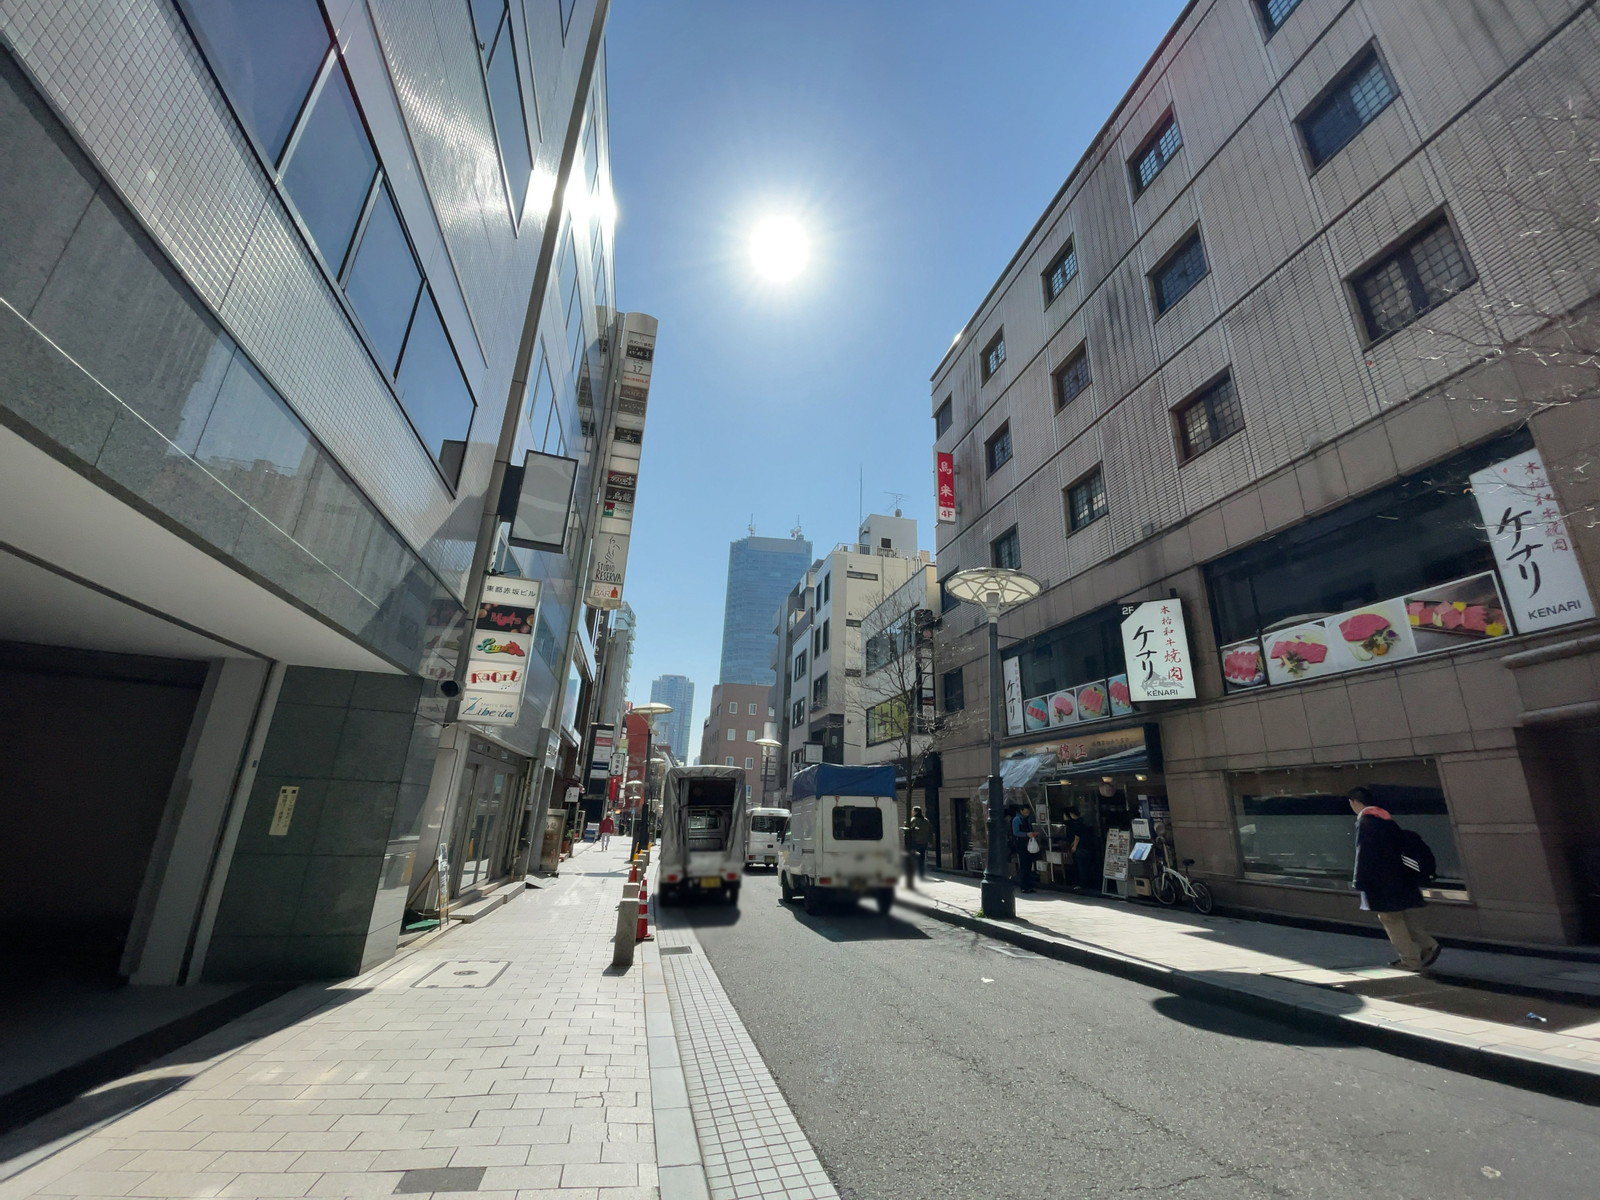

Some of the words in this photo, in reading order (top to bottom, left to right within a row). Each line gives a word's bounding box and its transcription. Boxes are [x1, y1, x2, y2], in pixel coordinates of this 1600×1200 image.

[941, 510, 953, 519] 4F
[1496, 507, 1543, 600] ケナリ
[595, 569, 622, 583] RESERVA
[486, 585, 536, 598] 東都赤坂ビル
[593, 589, 610, 598] BAR
[1121, 605, 1134, 615] 2F
[1528, 599, 1582, 620] KENARI
[1132, 625, 1158, 683] ケナリ
[1146, 688, 1178, 697] KENARI
